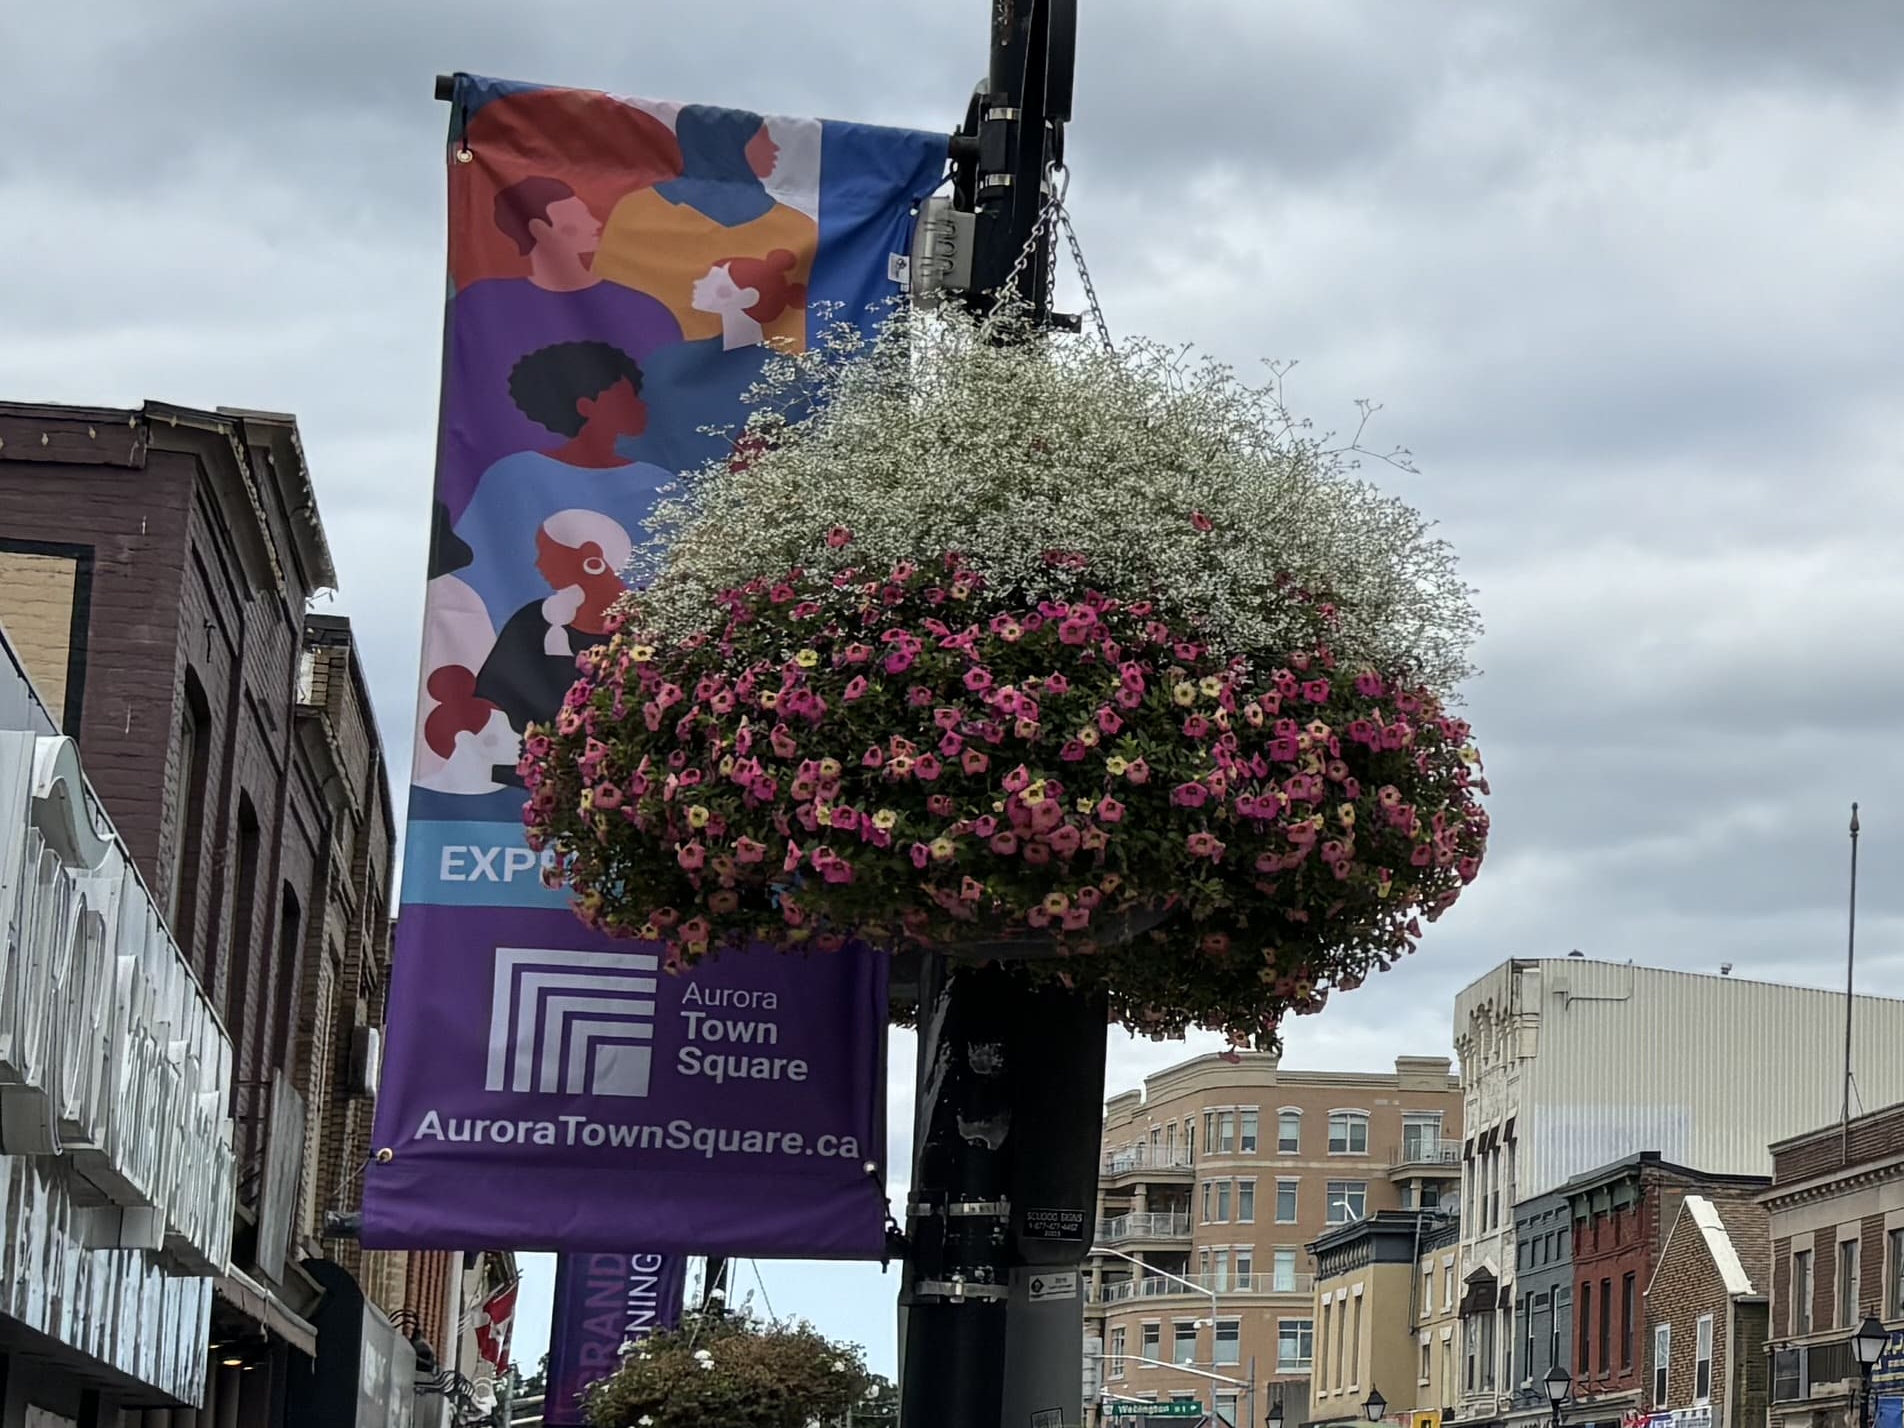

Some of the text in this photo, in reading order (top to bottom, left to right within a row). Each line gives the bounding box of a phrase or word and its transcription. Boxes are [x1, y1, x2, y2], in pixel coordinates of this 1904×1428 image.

[681, 981, 778, 1010] Aurora
[680, 1010, 778, 1045] Town
[677, 1045, 808, 1083] Square
[414, 1109, 860, 1159] AuroraTownSquare.ca
